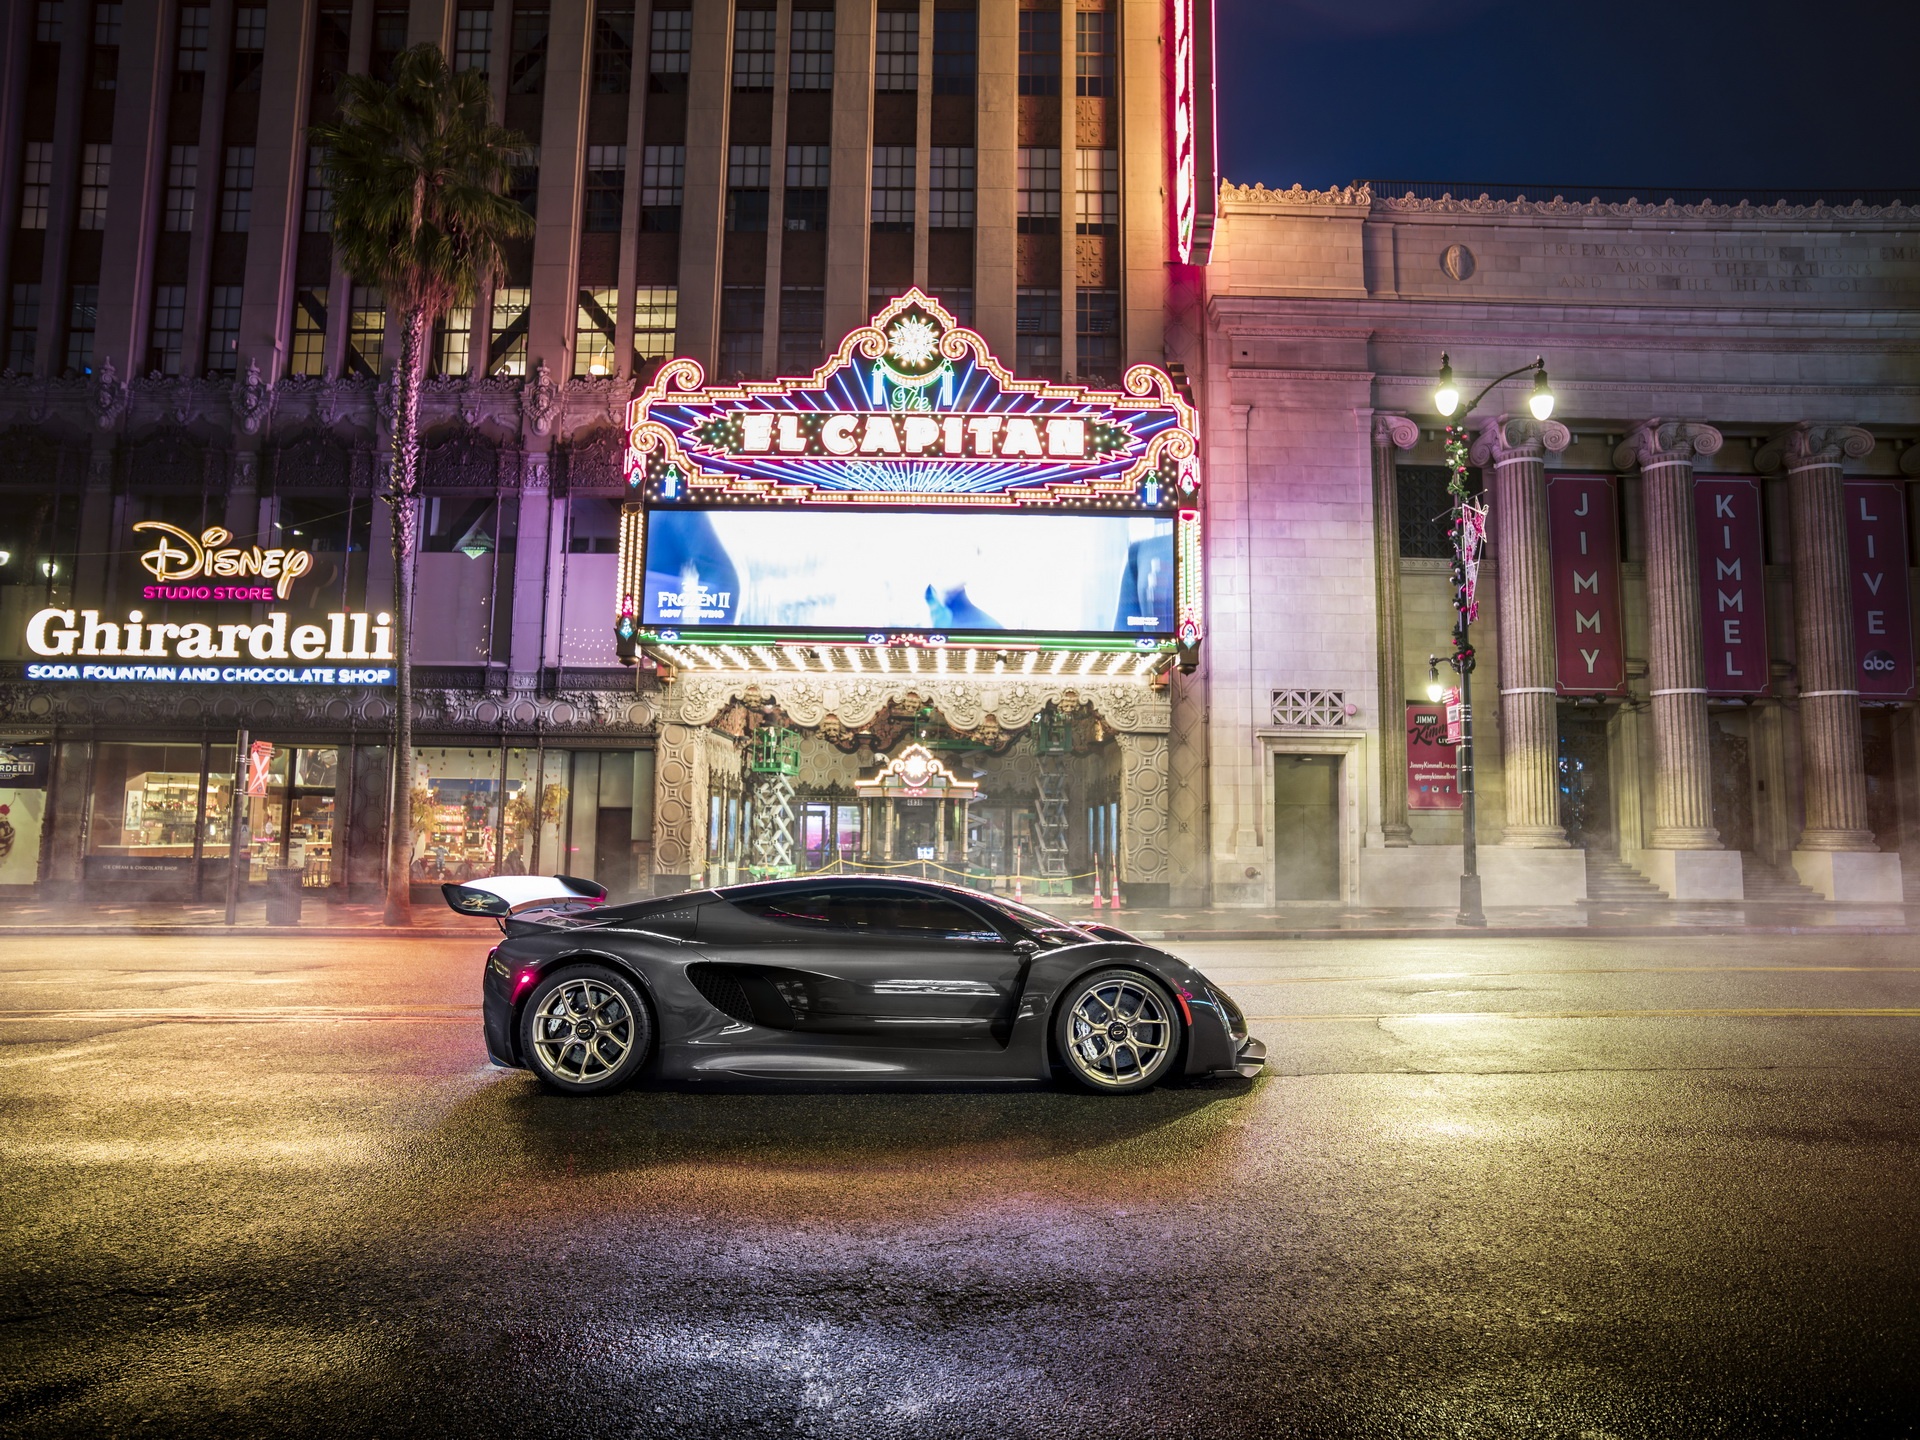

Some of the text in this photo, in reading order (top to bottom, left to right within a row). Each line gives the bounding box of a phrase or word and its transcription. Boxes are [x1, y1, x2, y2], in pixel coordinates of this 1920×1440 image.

[1543, 243, 1690, 258] FREEMASONRY
[1712, 246, 1789, 259] BUILDS
[1811, 247, 1843, 259] ITS
[1614, 261, 1873, 275] AMONG THE NATIONS
[1560, 276, 1602, 288] AND
[1628, 277, 1650, 289] IN
[1672, 278, 1712, 291] THE
[1736, 279, 1813, 292] HEARTS
[1838, 280, 1862, 292] OF
[891, 386, 932, 411] The
[741, 413, 1085, 458] EL CAPITAN
[1860, 497, 1886, 635] LIVE
[1572, 492, 1601, 674] JIMMY
[1715, 494, 1744, 677] KIMMEL
[143, 585, 274, 600] STUDIO STORE
[658, 592, 718, 608] FROEN
[26, 607, 394, 661] Ghirardelli
[1863, 658, 1895, 671] abc
[27, 664, 391, 683] SODA FOUNTAIN AND CHOCOLATE SHOP
[1416, 716, 1437, 724] JIMMY
[1409, 761, 1458, 770] JimmyKimmelLive.co
